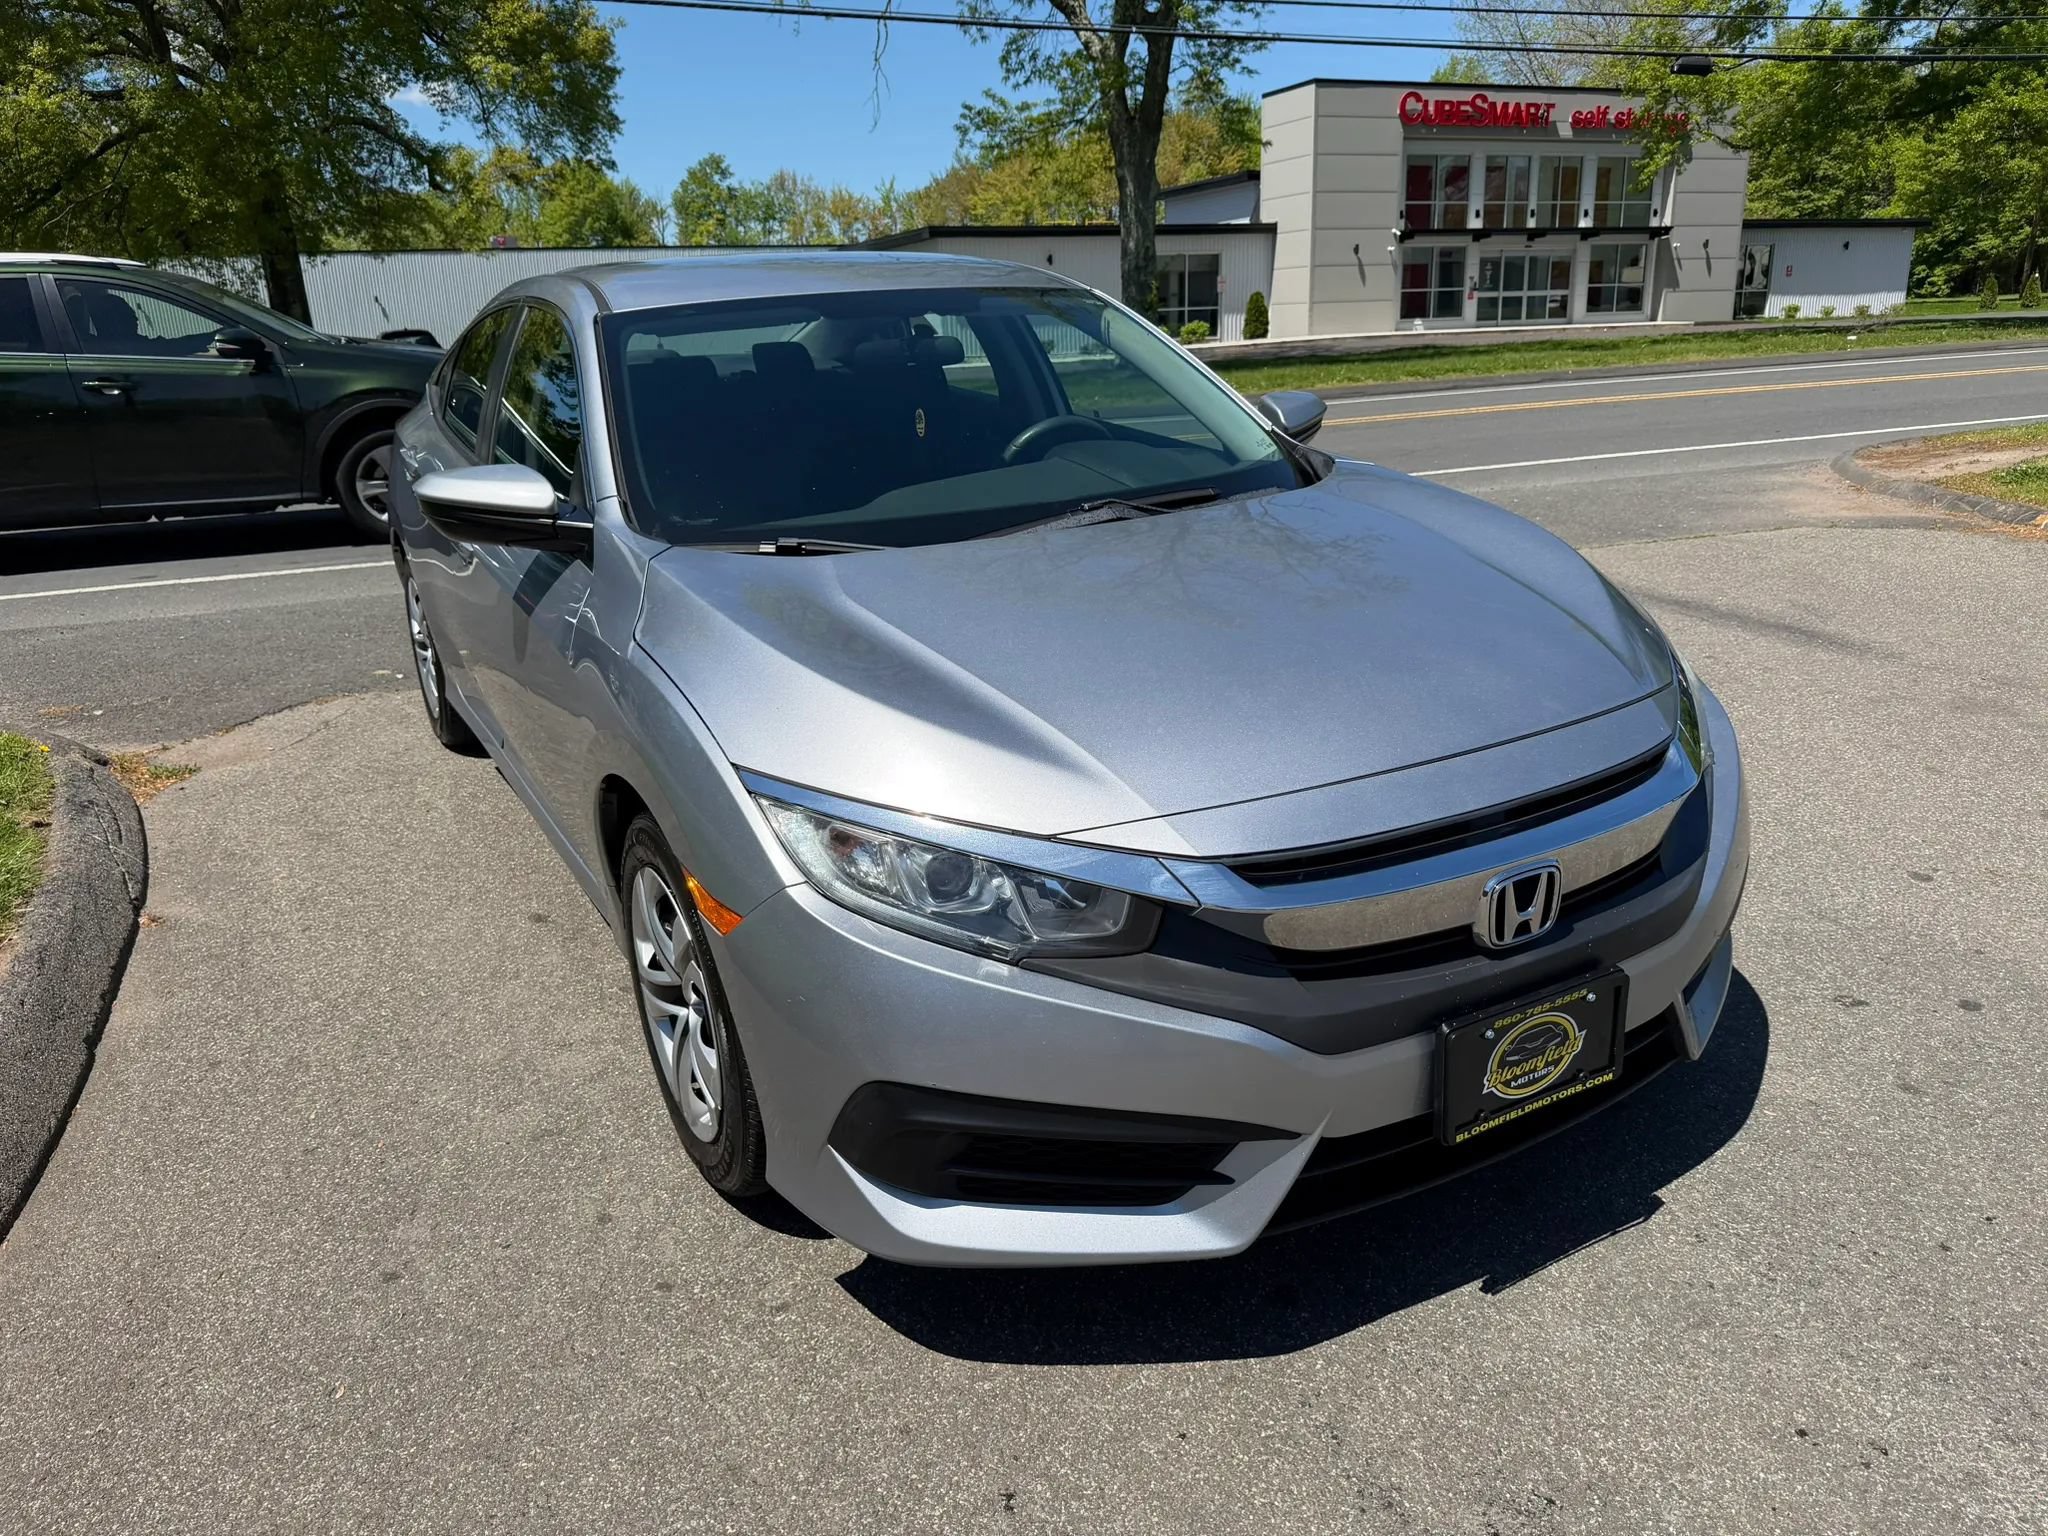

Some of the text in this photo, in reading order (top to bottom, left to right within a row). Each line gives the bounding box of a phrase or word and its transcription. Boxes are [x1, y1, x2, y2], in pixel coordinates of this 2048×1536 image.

[1570, 105, 1610, 129] self
[1493, 988, 1589, 1029] 860-785-5555
[1486, 1032, 1584, 1088] Bloomfield
[1510, 1064, 1556, 1088] MOTORS
[1455, 1072, 1615, 1144] BLOOMFIELDMOTORS.COM
